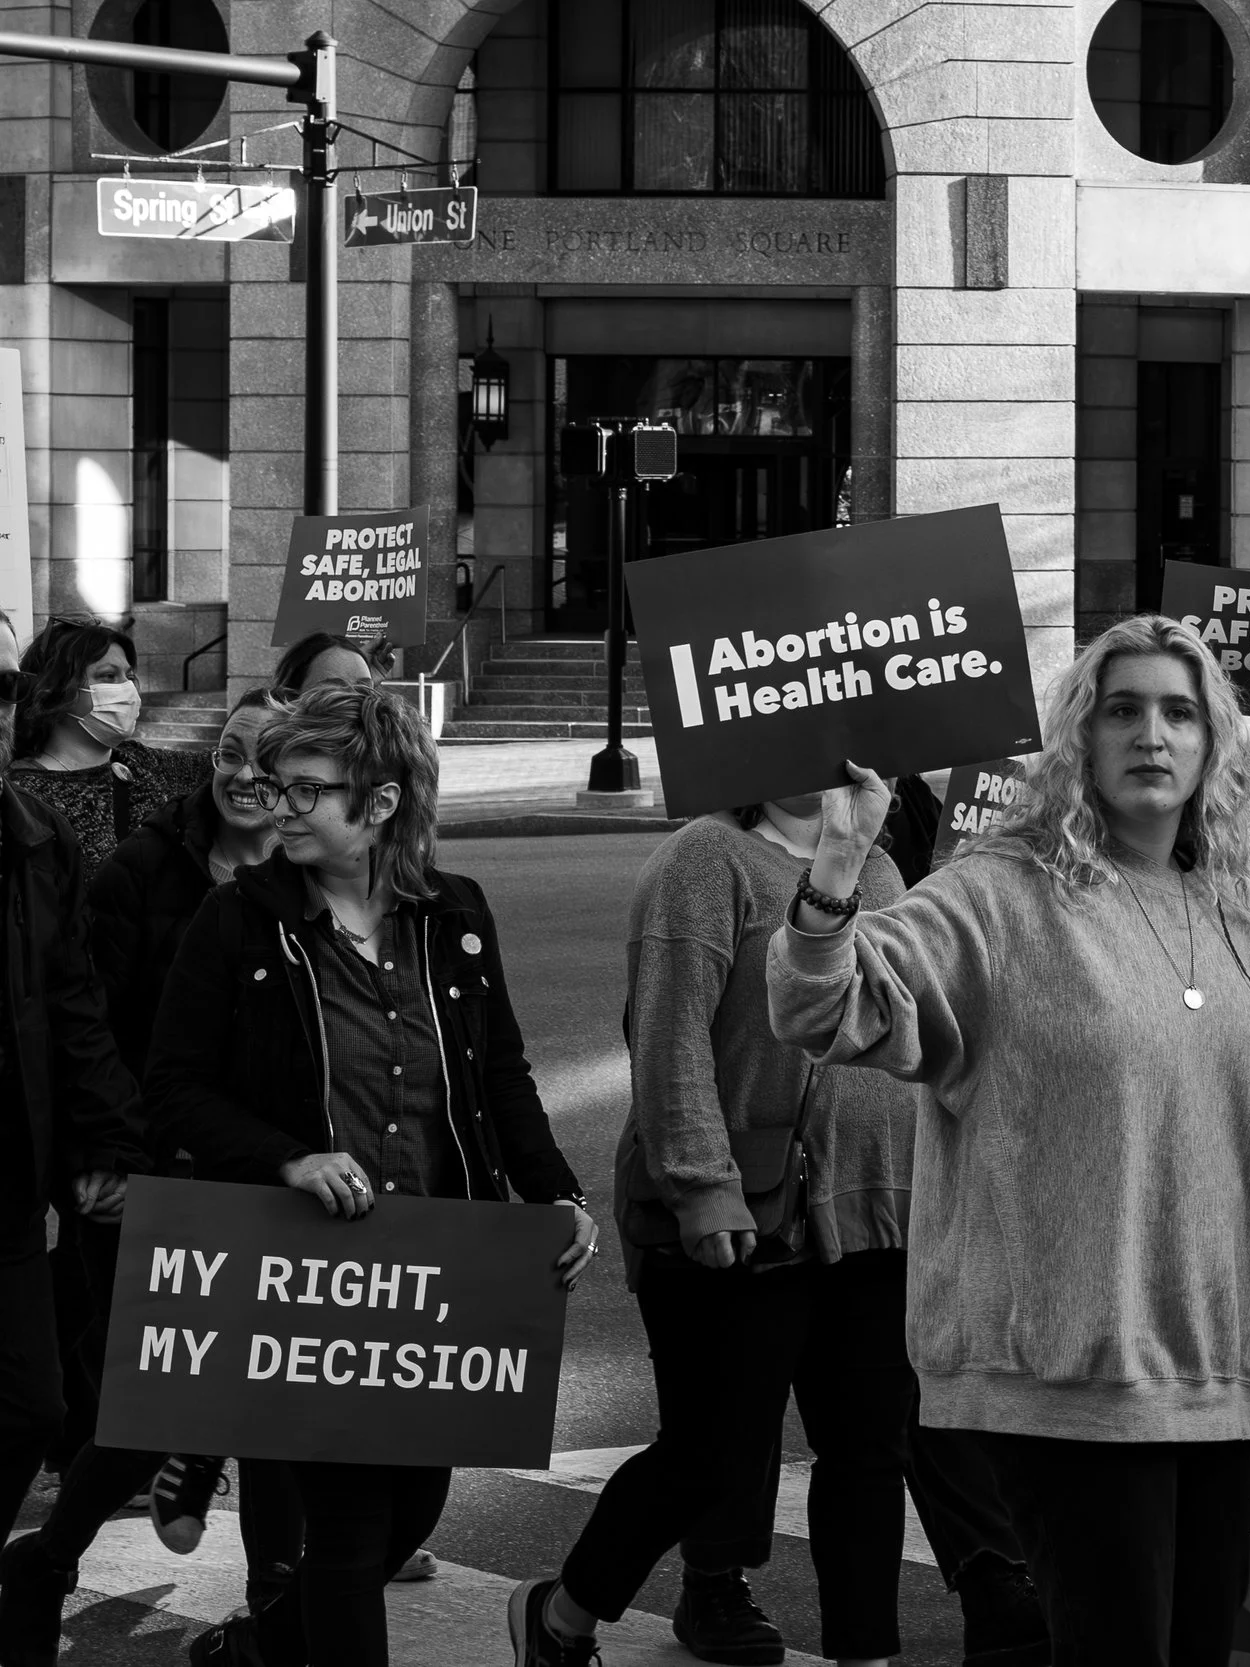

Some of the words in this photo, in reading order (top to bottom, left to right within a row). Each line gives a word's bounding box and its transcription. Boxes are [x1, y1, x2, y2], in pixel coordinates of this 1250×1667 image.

[113, 189, 197, 227] Spring
[209, 193, 236, 226] St
[386, 203, 434, 233] Union
[446, 201, 466, 231] St
[546, 230, 708, 252] PORTLAND
[736, 231, 851, 257] SQUARE
[325, 523, 414, 550] PROTECT
[300, 554, 370, 578] SAFE,
[376, 548, 421, 574] LEGAL
[304, 575, 416, 601] ABORTION
[708, 611, 920, 675] Abortion
[928, 598, 968, 637] is
[714, 661, 873, 722] Health
[884, 650, 1003, 691] Care.
[149, 1247, 228, 1296] MY
[257, 1255, 449, 1323] RIGHT,
[139, 1326, 218, 1375] MY
[247, 1334, 528, 1392] DECISION
